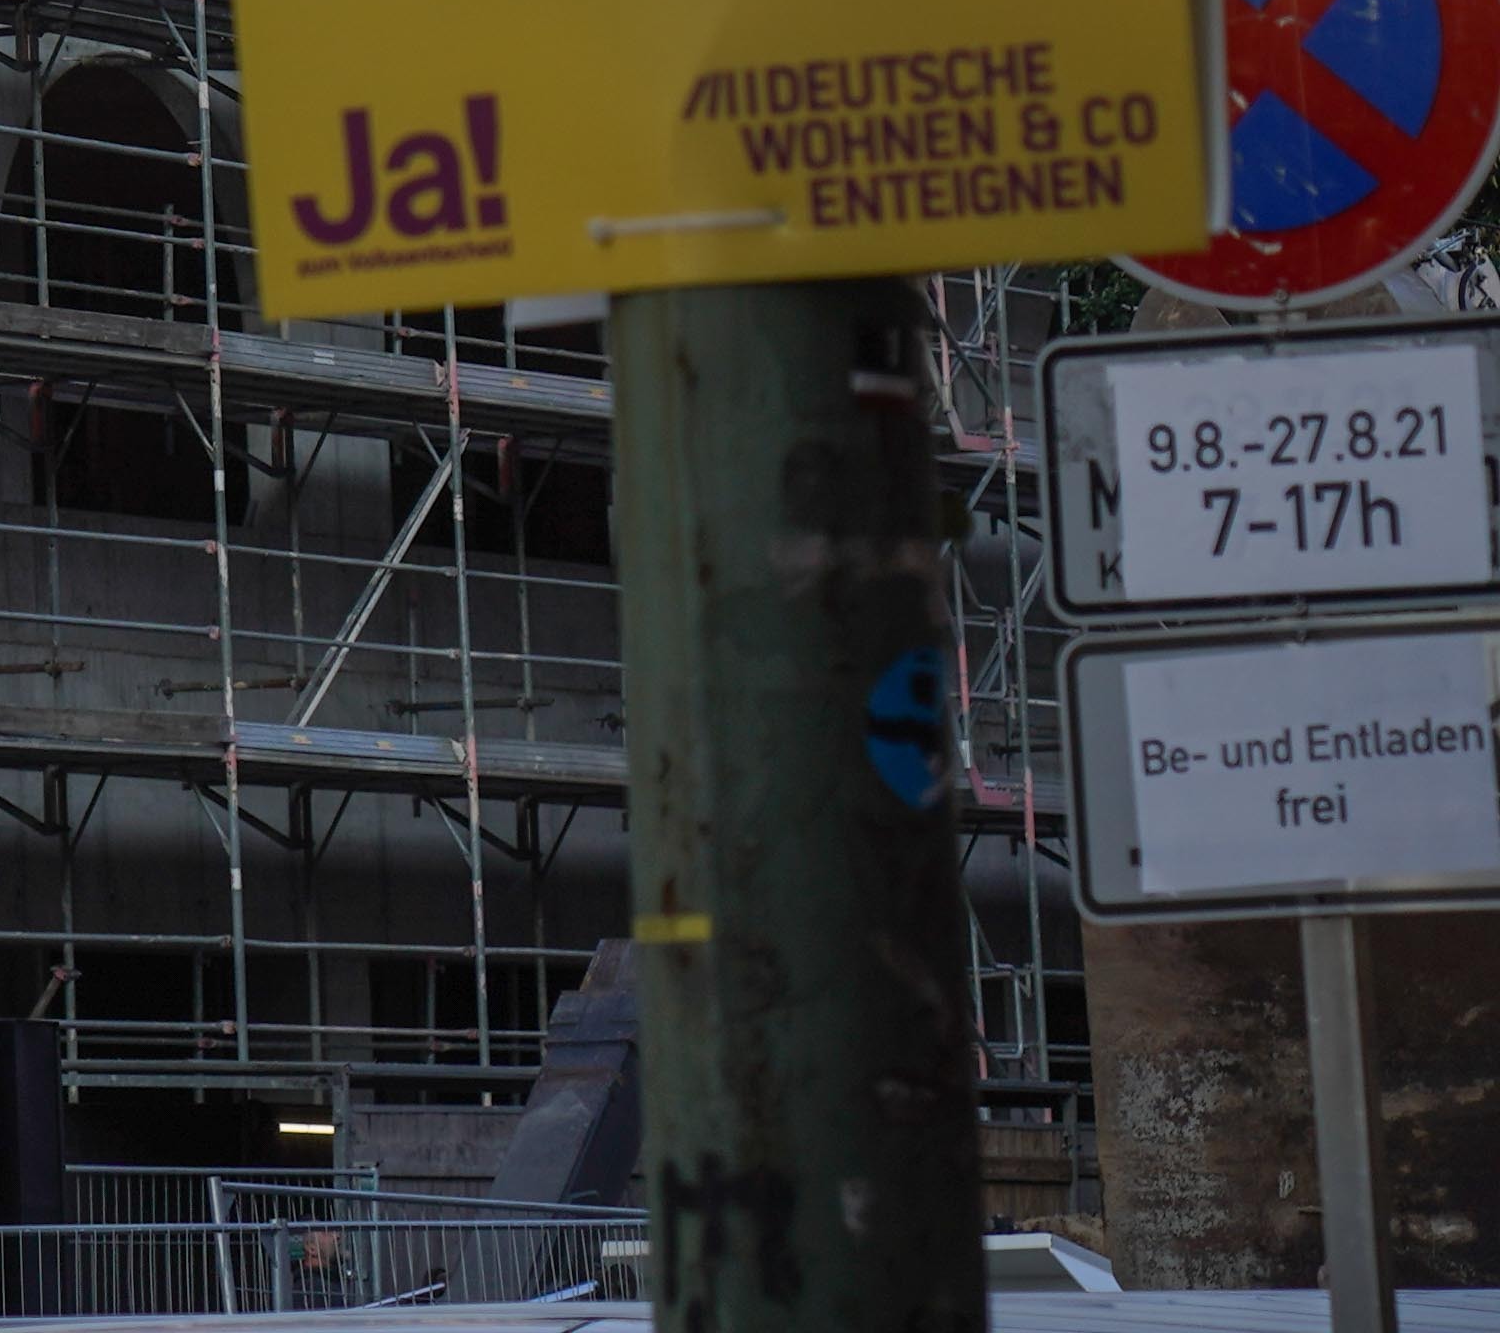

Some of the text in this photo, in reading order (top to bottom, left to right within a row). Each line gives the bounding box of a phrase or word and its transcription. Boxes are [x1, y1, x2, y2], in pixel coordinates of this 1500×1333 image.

[774, 42, 1052, 118] DEUTSCHE
[740, 93, 1157, 173] WOHNEN & CO
[291, 93, 508, 248] Ja!
[808, 156, 1124, 229] ENTEIGNEN
[1147, 406, 1448, 474] 9.8.-27.8.21
[1201, 478, 1402, 558] 7-17h
[1141, 717, 1484, 776] Be- und Entladen
[1275, 784, 1348, 827] frei
